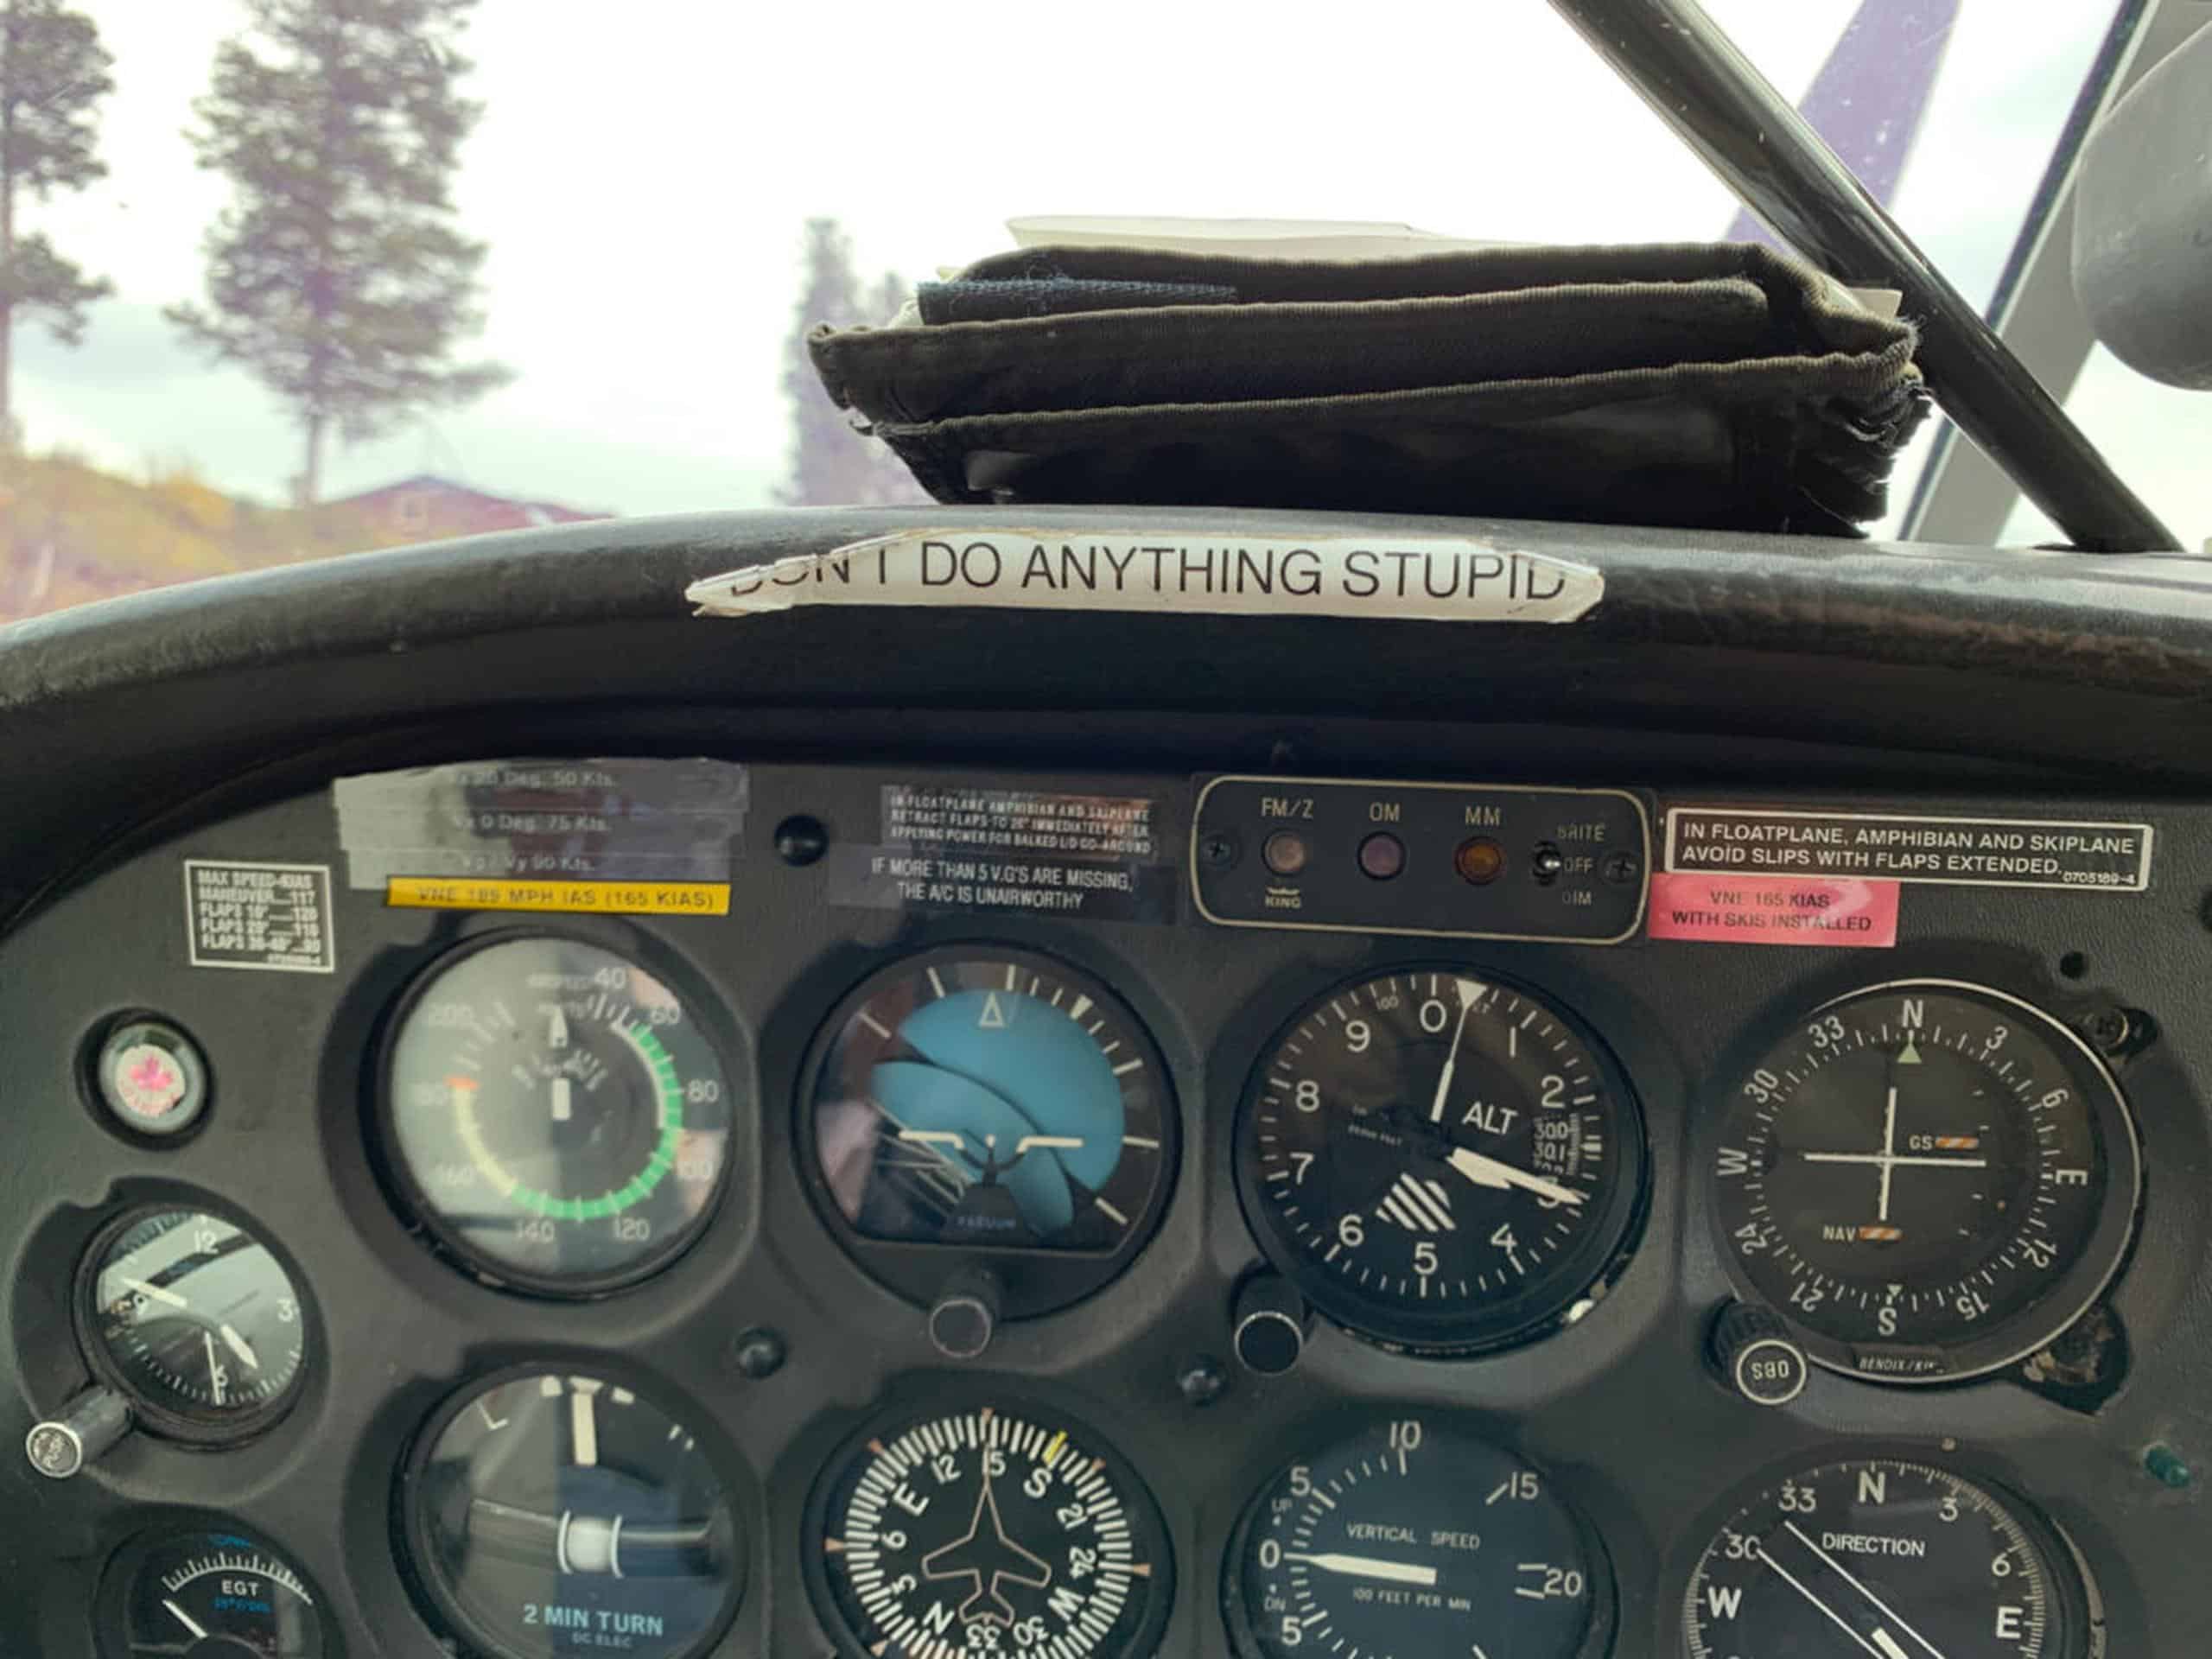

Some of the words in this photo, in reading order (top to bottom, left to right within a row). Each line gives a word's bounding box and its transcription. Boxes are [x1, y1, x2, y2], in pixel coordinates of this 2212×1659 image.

[921, 542, 1001, 588] DO
[1021, 542, 1321, 596] ANYTHING
[1343, 550, 1566, 601] STUPID
[1261, 797, 1314, 820] FM/Z
[1369, 803, 1400, 823] OM
[1465, 807, 1501, 827] MM
[1684, 823, 1705, 840] IN
[1711, 823, 1850, 846] FLOATPLANE,
[1855, 829, 1976, 849] AMPHIBIAN
[1981, 833, 2025, 850] AND
[2029, 835, 2135, 855] SKIPLANE
[872, 856, 886, 874] IF
[890, 859, 933, 878] MORE
[938, 861, 975, 880] THAN
[979, 863, 988, 880] 5
[1033, 867, 1061, 886] ARE
[1563, 856, 1593, 874] OFF
[1682, 845, 1747, 863] AVOID
[1751, 847, 1810, 866] SLIPS
[1816, 850, 1869, 868] WITH
[1875, 852, 1941, 872] FLAPS
[1947, 855, 2063, 876] EXTENDED.
[508, 888, 554, 905] MPH
[563, 889, 595, 906] IAS
[656, 892, 715, 910] KIAS)
[898, 881, 925, 900] THE
[958, 886, 973, 904] IS
[976, 887, 1084, 910] UNAIRWORTHY
[1755, 892, 1785, 906] 165
[1789, 893, 1831, 907] KIAS
[1672, 911, 1719, 926] WITH
[1725, 912, 1768, 929] SKIS
[1772, 913, 1872, 932] INSTALLED
[594, 967, 626, 990] 40
[1419, 999, 1447, 1033] 0
[1902, 999, 1924, 1028] N
[1345, 1020, 1371, 1053] 9
[1808, 1015, 1846, 1048] 33
[1986, 1026, 2009, 1052] 3
[689, 1080, 720, 1103] 80
[1295, 1080, 1321, 1113] 8
[1541, 1075, 1567, 1109] 2
[1744, 1068, 1780, 1104] 30
[2042, 1088, 2069, 1109] 6
[1462, 1101, 1519, 1135] ALT
[1909, 1135, 1933, 1151] GS
[1289, 1152, 1314, 1185] 7
[1716, 1147, 1749, 1177] W
[2055, 1167, 2088, 1186] E
[194, 1229, 219, 1255] 12
[612, 1217, 652, 1242] 120
[1339, 1214, 1365, 1247] 6
[1491, 1223, 1519, 1255] 4
[1734, 1223, 1770, 1256] 24
[1822, 1225, 1857, 1243] NAV
[1414, 1242, 1439, 1274] 5
[2022, 1241, 2058, 1269] 12
[277, 1299, 295, 1323] 3
[1789, 1281, 1826, 1313] 21
[1955, 1293, 1992, 1321] 15
[1878, 1307, 1898, 1337] S
[1751, 1359, 1790, 1380] OBS
[1389, 1420, 1422, 1451] 10
[931, 1454, 962, 1484] 12
[1023, 1468, 1053, 1499] S
[1289, 1465, 1312, 1497] 5
[893, 1482, 931, 1517] E
[1509, 1471, 1541, 1500] 15
[1777, 1486, 1817, 1513] 33
[1858, 1470, 1887, 1505] N
[1055, 1503, 1090, 1530] 21
[1271, 1499, 1293, 1513] UP
[1938, 1497, 1960, 1522] 3
[1346, 1523, 1417, 1544] VERTICAL
[1430, 1531, 1481, 1549] SPEED
[1725, 1534, 1761, 1560] 30
[1821, 1532, 1926, 1558] DIRECTION
[1069, 1546, 1097, 1580] 24
[1259, 1539, 1281, 1569] 0
[1991, 1552, 2012, 1578] 6
[221, 1579, 259, 1597] EGT
[891, 1573, 918, 1595] 3
[1542, 1569, 1583, 1597] 20
[1046, 1586, 1086, 1623] W
[1264, 1596, 1287, 1612] DN
[1352, 1588, 1372, 1603] 100
[1378, 1591, 1410, 1605] FEET
[1415, 1594, 1443, 1608] PER
[1447, 1597, 1471, 1612] MIN
[1707, 1586, 1743, 1619] W
[523, 1603, 539, 1624] 2
[543, 1605, 589, 1630] MIN
[596, 1610, 664, 1637] TURN
[922, 1600, 957, 1636] N
[1012, 1615, 1050, 1647] 30
[1281, 1616, 1303, 1645] 5
[1995, 1606, 2024, 1639] E
[965, 1623, 1001, 1650] 33
